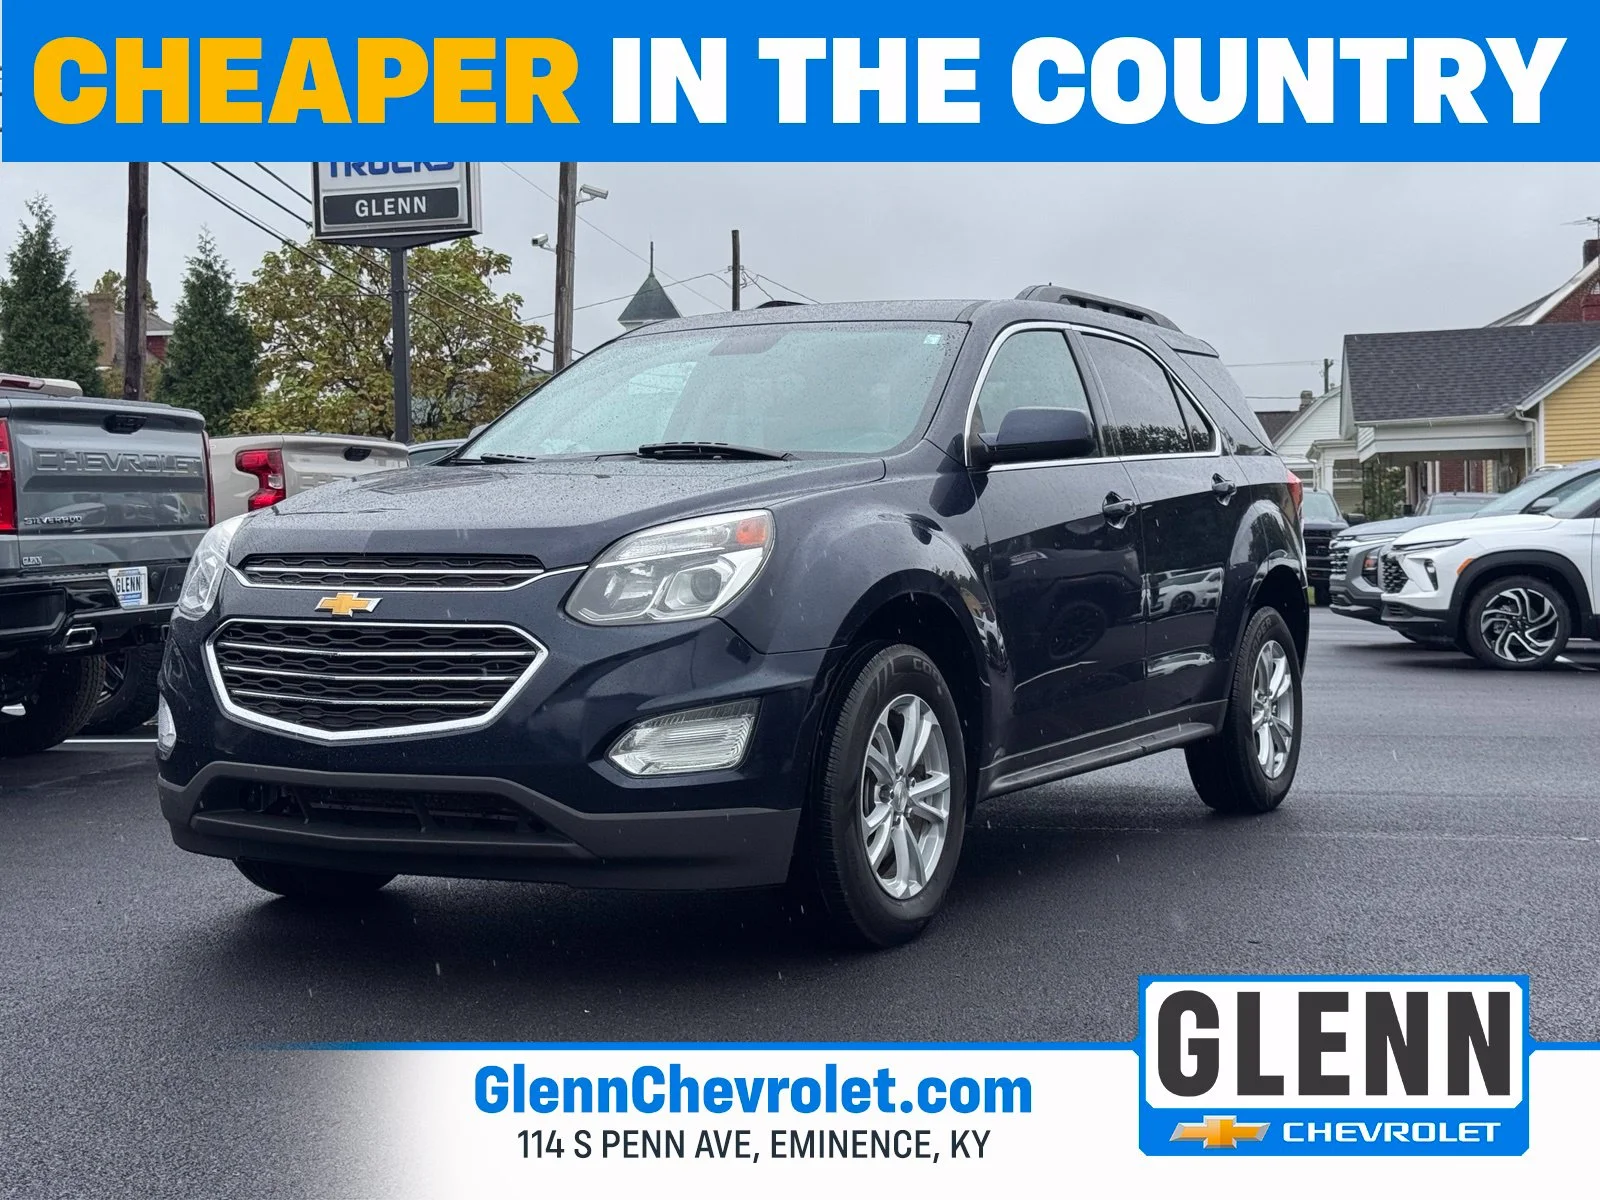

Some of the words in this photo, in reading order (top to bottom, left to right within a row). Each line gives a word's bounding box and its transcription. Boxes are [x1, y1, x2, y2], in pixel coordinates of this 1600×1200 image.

[355, 195, 427, 217] GLENN
[36, 450, 204, 475] CHEVROLET
[116, 576, 141, 593] GLENN
